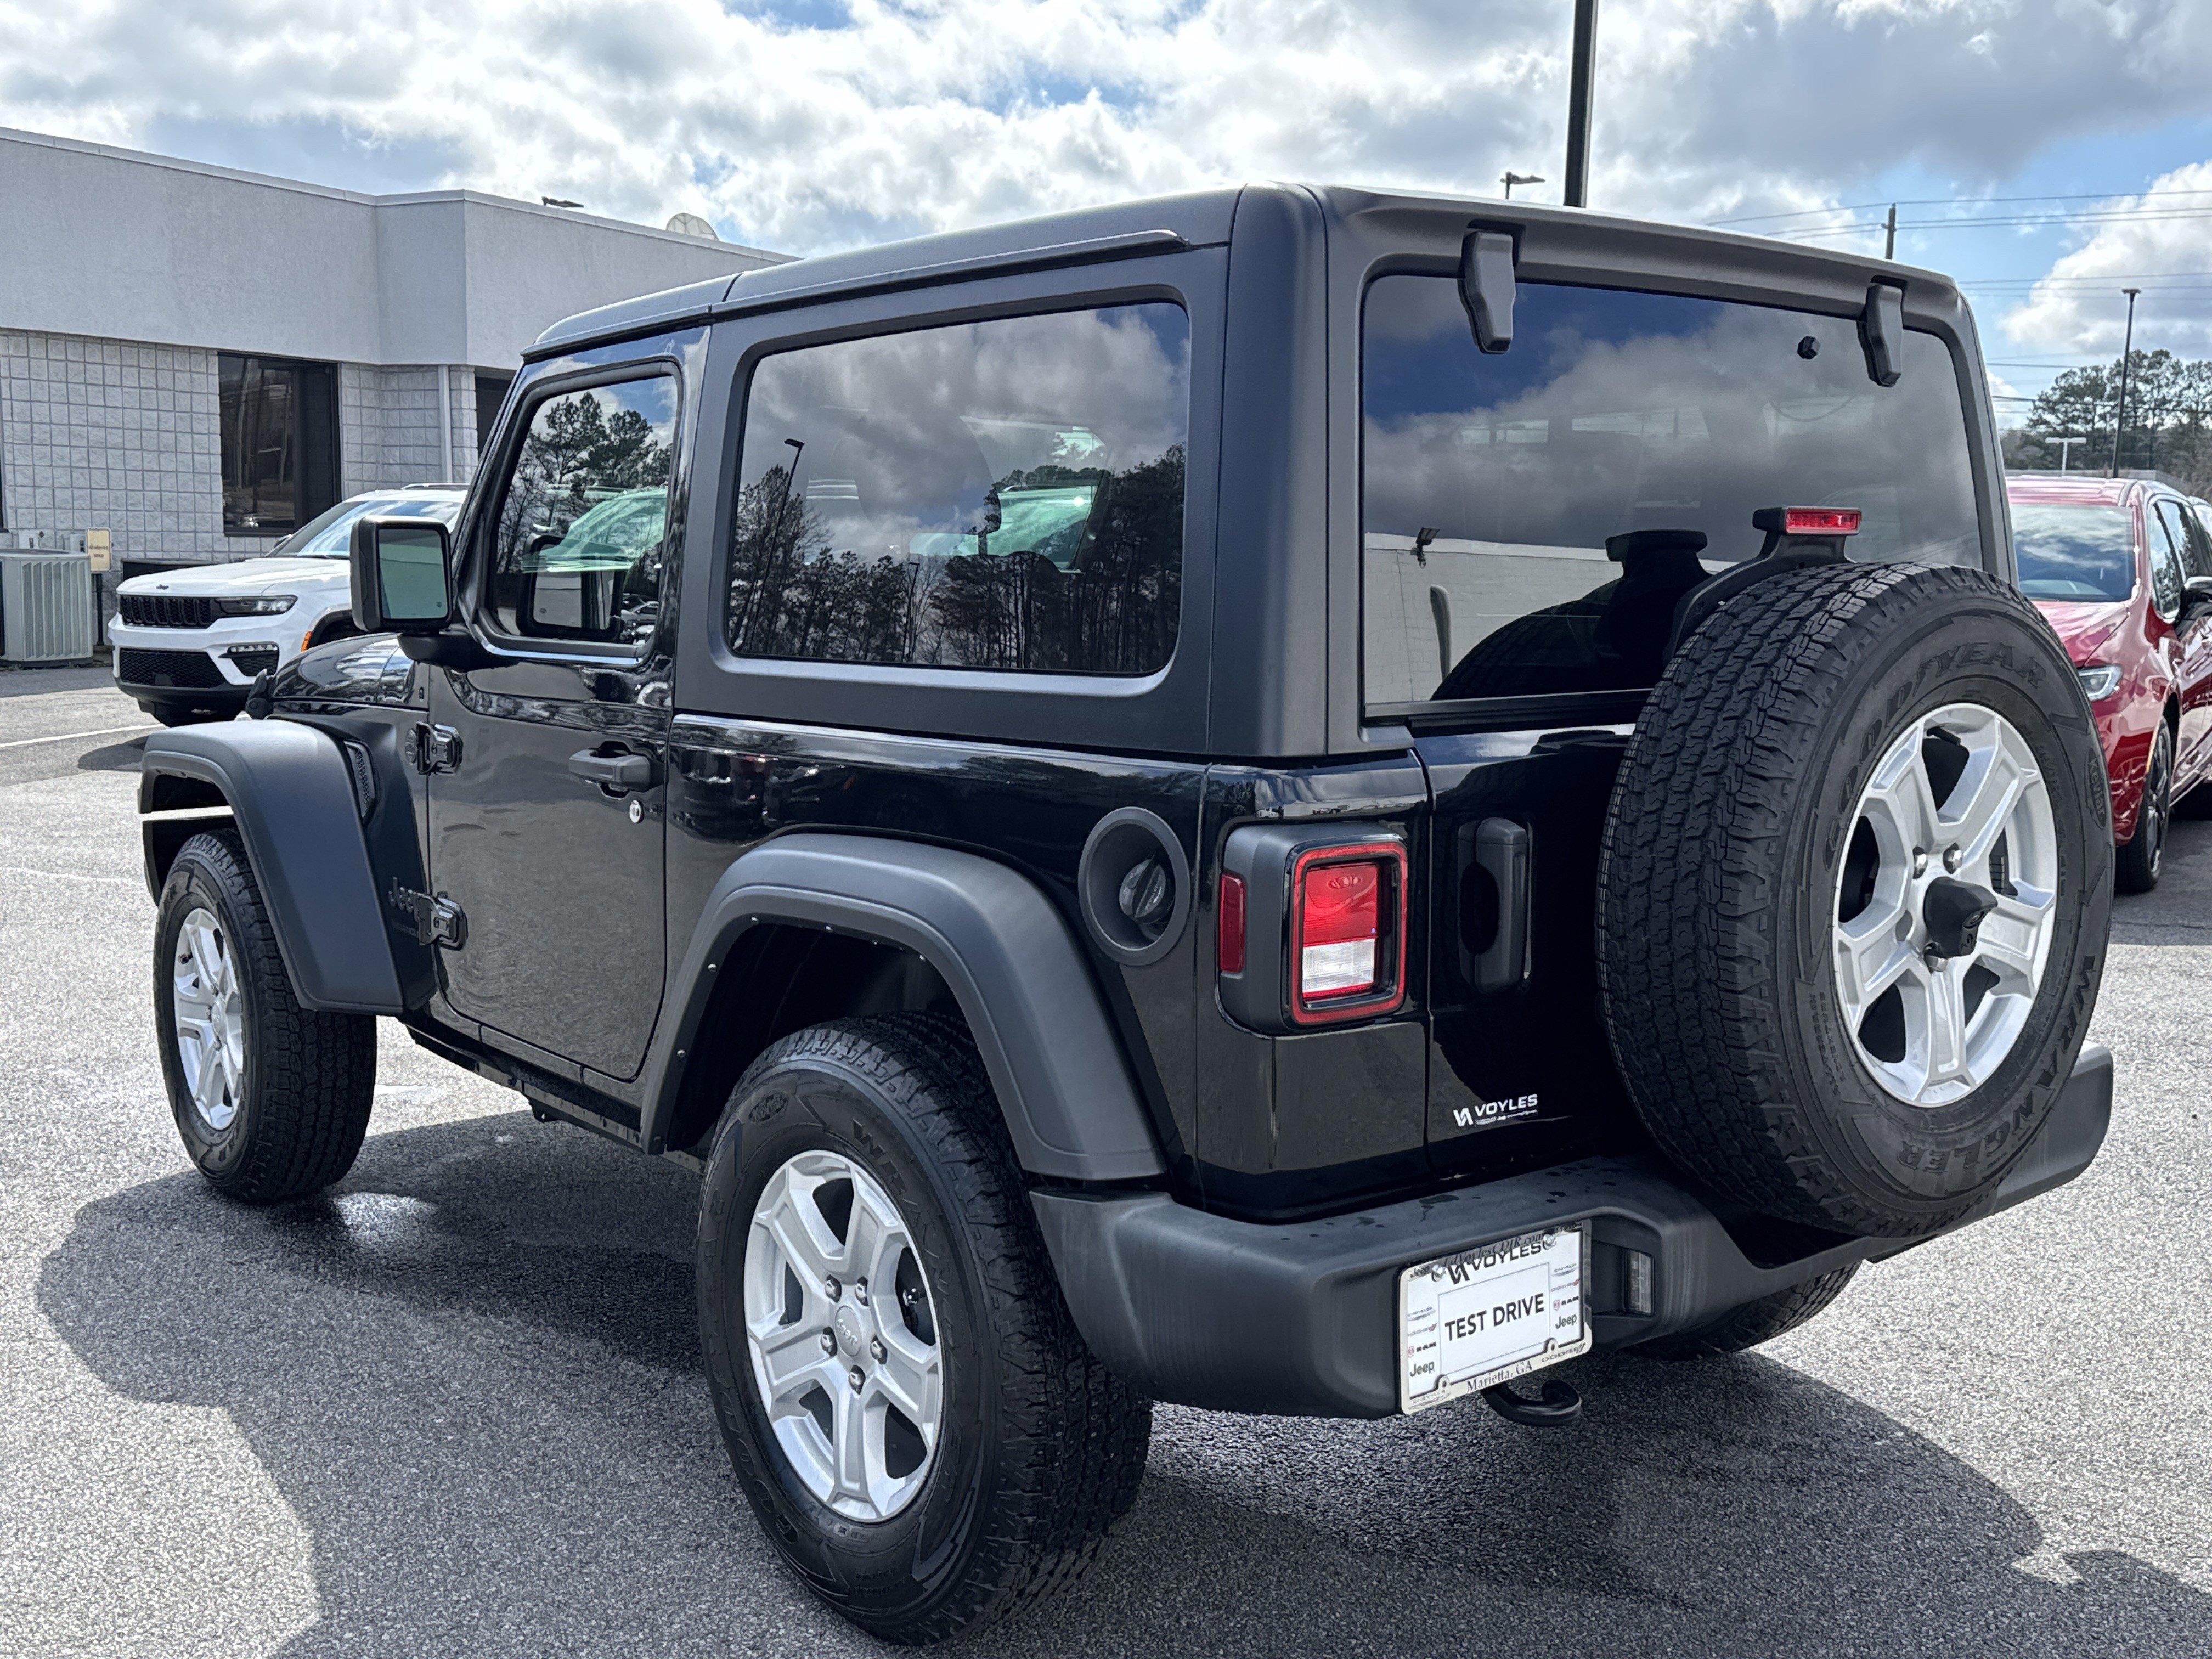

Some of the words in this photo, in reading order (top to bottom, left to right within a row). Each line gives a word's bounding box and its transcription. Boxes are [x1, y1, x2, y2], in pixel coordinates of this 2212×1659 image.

[1823, 641, 2047, 872] GOODYEAR
[2089, 757, 2106, 816] Kevlar
[1897, 955, 2096, 1173] WRANGLER
[1474, 1093, 1538, 1117] VOYLES
[1472, 1240, 1542, 1271] VOYLES
[1561, 1295, 1579, 1306] RAM
[1444, 1310, 1487, 1341] TEST
[1493, 1292, 1545, 1327] DRIVE
[1555, 1314, 1577, 1329] Jeep
[837, 1318, 859, 1346] Jeep
[1416, 1341, 1437, 1352] RAM
[1409, 1361, 1435, 1378] Jeep
[1466, 1371, 1514, 1393] Marietta,
[1515, 1360, 1533, 1375] GA
